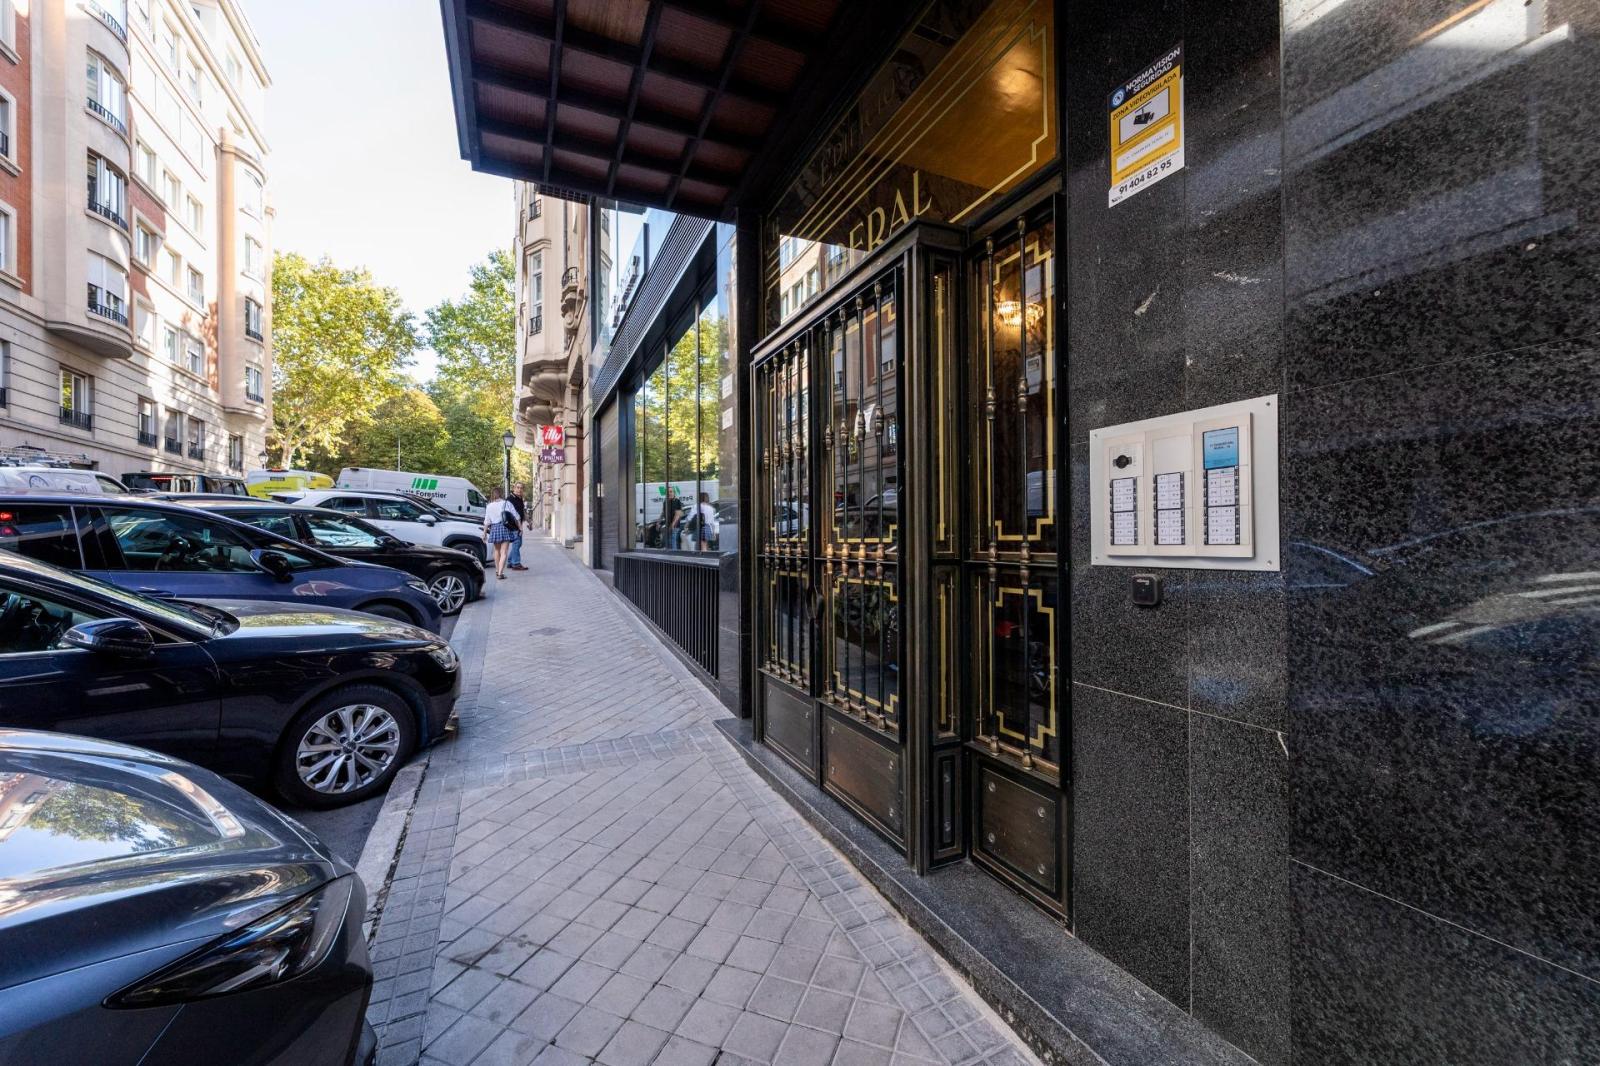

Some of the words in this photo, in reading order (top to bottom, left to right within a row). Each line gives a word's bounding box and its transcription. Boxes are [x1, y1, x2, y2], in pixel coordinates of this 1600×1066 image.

[1125, 47, 1181, 93] NORMAVISION
[1133, 62, 1173, 94] SEGURIDAD
[1112, 105, 1129, 121] ZONA
[1129, 73, 1178, 108] VIDEOVIGILADA
[1119, 183, 1128, 195] 91
[1129, 174, 1145, 189] 404
[1146, 166, 1159, 179] 82
[1160, 158, 1172, 171] 95
[544, 428, 562, 442] illy
[415, 489, 448, 499] Forestier
